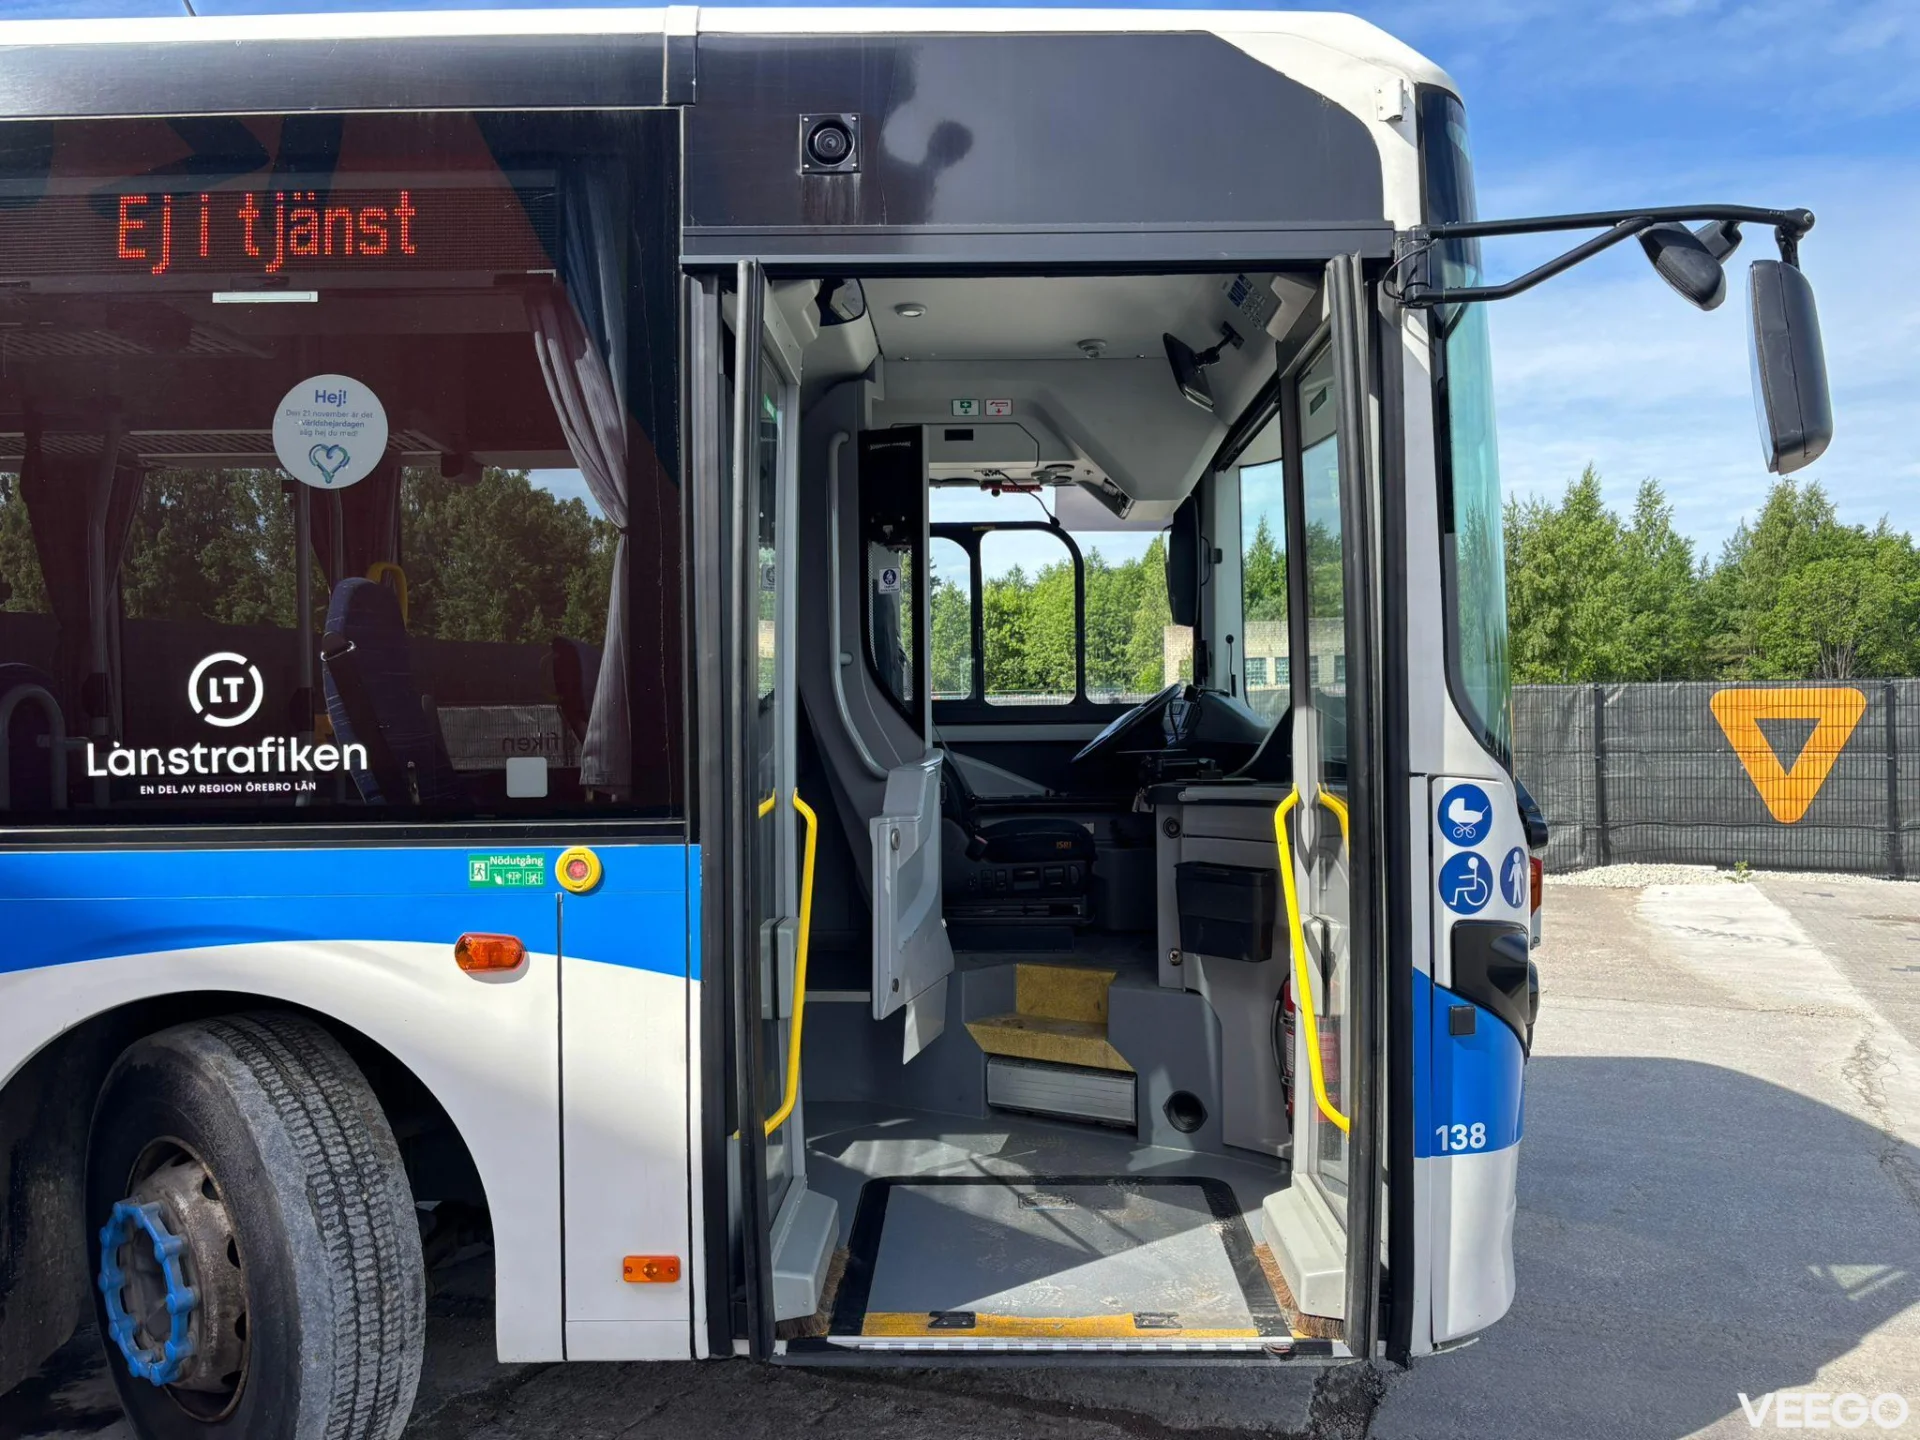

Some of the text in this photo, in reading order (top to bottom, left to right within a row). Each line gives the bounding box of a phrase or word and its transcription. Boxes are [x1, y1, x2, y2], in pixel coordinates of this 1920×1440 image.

[117, 190, 417, 275] Ej i tjänst
[314, 389, 347, 407] Hej!
[285, 409, 373, 419] Den 21 november är det
[299, 429, 313, 437] säg
[314, 429, 326, 438] hej
[327, 429, 338, 437] du
[209, 677, 244, 703] LT
[140, 780, 317, 795] EN DEL AV REGION ÖREBRO LÄN
[489, 856, 543, 868] Nödutgång
[1435, 1121, 1487, 1151] 138
